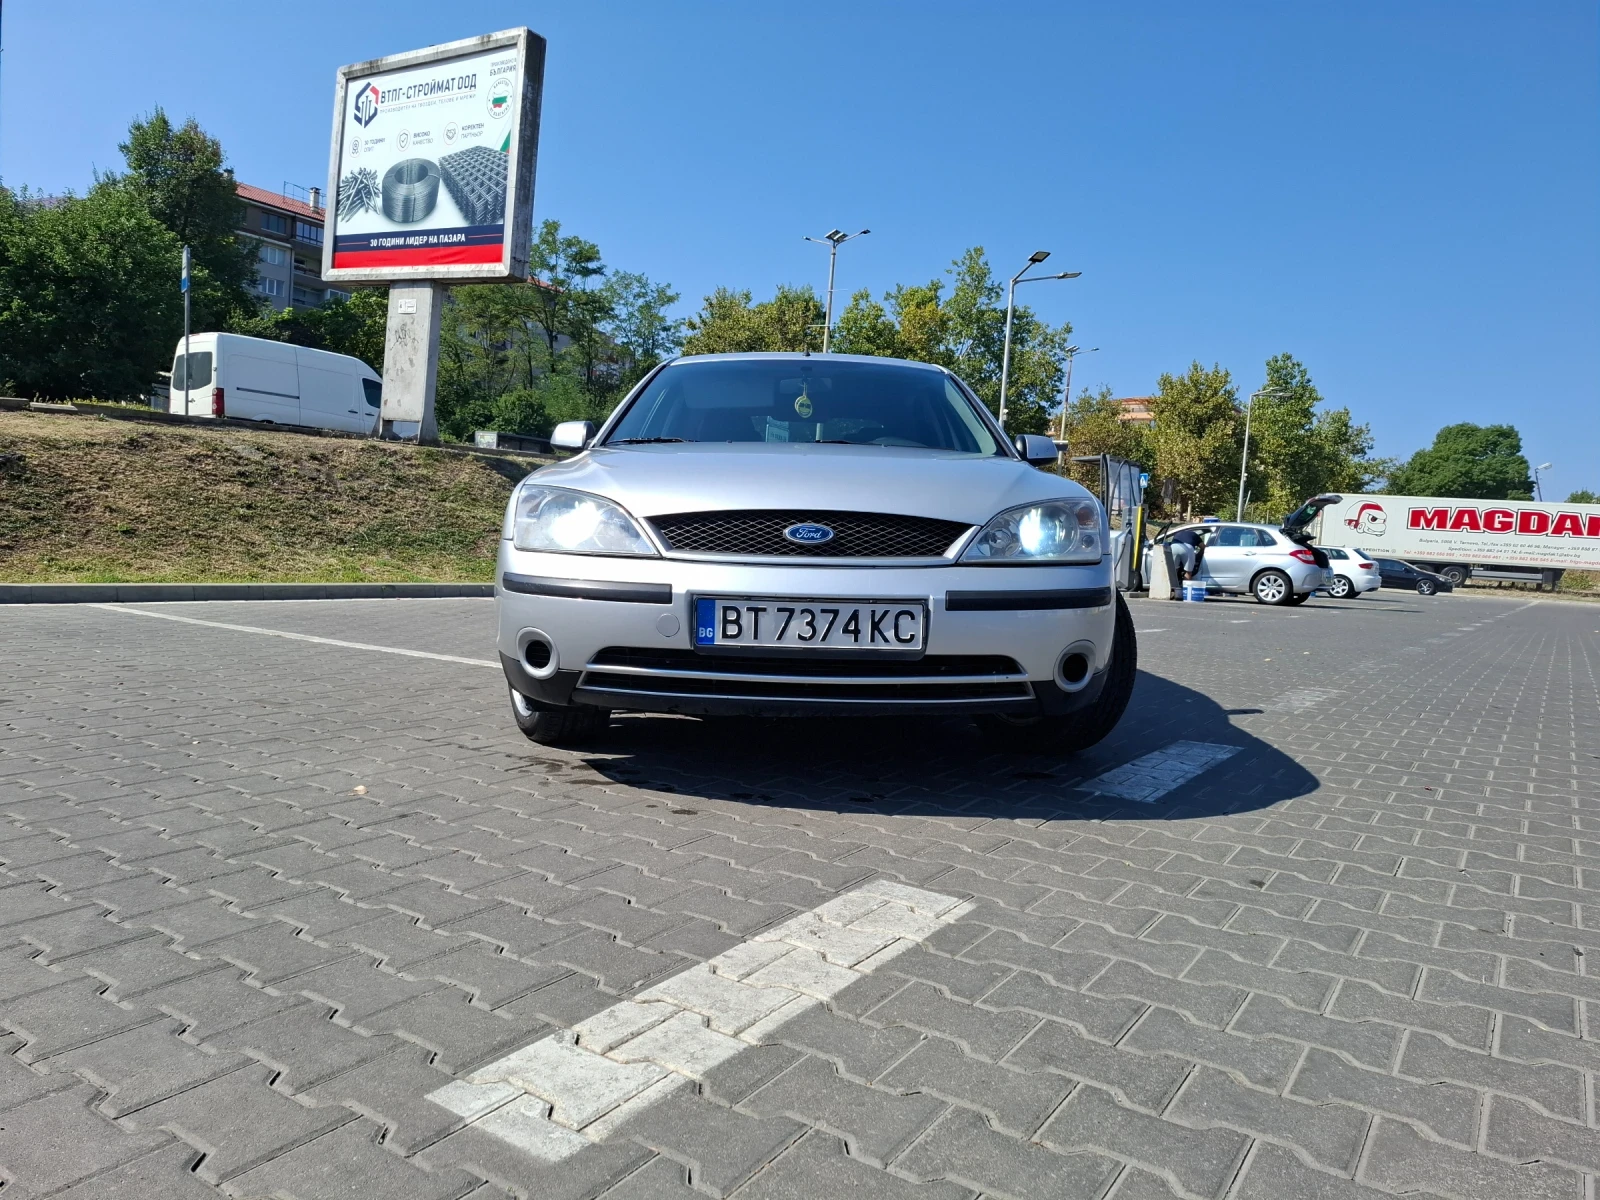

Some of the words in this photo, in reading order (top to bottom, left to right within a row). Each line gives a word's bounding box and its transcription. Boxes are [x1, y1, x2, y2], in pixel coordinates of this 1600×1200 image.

[490, 64, 517, 77] БЪЛГАРИЯ
[380, 77, 456, 104] ВТПГ-СТРОЙМАТ
[457, 73, 477, 90] ООД
[461, 122, 485, 132] КОРЕКТЕН
[413, 130, 431, 139] ВИСОКО
[412, 138, 434, 146] КАЧЕСТВО
[370, 238, 378, 247] 30
[378, 237, 405, 248] ГОДИНИ
[405, 236, 428, 246] ЛИДЕР
[428, 235, 438, 244] НА
[439, 233, 466, 244] ПАЗАРА
[796, 527, 822, 539] Ford
[721, 605, 767, 640] BT
[775, 608, 861, 643] 7374
[869, 609, 916, 644] KC
[698, 627, 714, 638] BG
